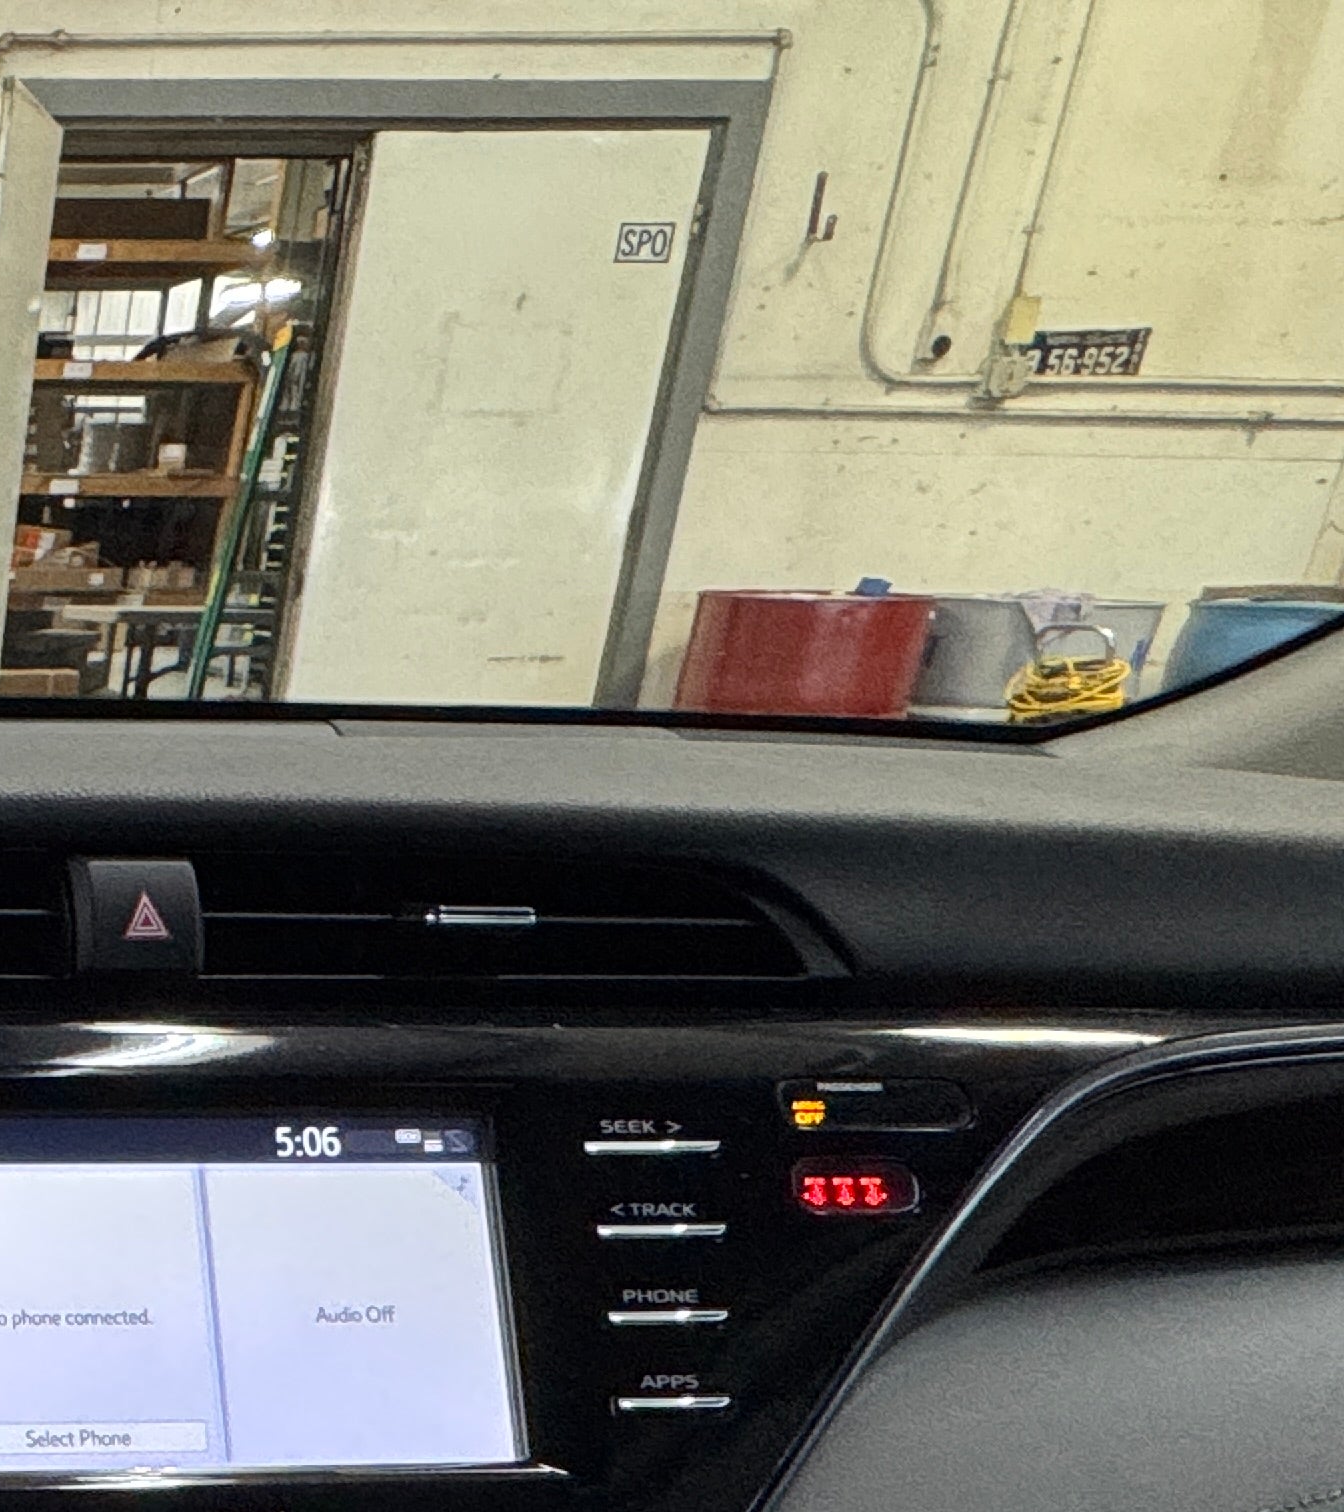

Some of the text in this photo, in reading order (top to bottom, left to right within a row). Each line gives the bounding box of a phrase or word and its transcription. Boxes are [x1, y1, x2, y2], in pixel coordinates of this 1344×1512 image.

[621, 228, 667, 257] SPO
[599, 1119, 655, 1134] SEEK
[274, 1127, 341, 1157] 5:06
[628, 1202, 698, 1218] TRACK
[622, 1288, 699, 1304] PHONE
[12, 1308, 61, 1330] phone
[65, 1308, 154, 1327] connected.
[315, 1305, 396, 1325] Audio Off
[640, 1375, 700, 1390] APPS
[25, 1429, 132, 1449] Select Phone
